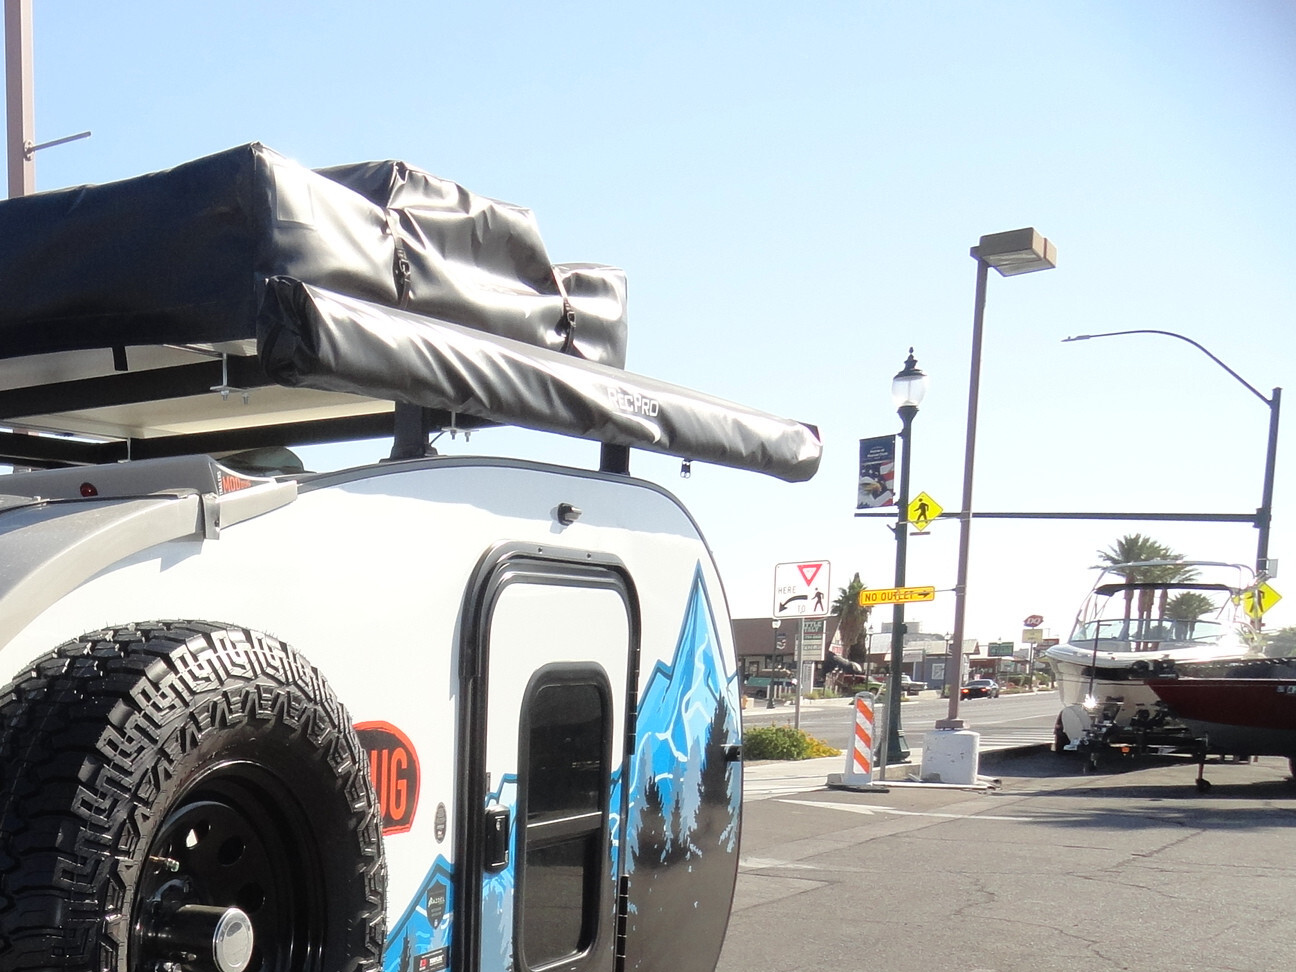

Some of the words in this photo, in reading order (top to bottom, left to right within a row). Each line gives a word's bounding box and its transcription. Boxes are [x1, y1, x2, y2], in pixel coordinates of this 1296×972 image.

[777, 586, 796, 594] HERE
[865, 592, 877, 602] NO
[881, 590, 914, 601] OUTLET
